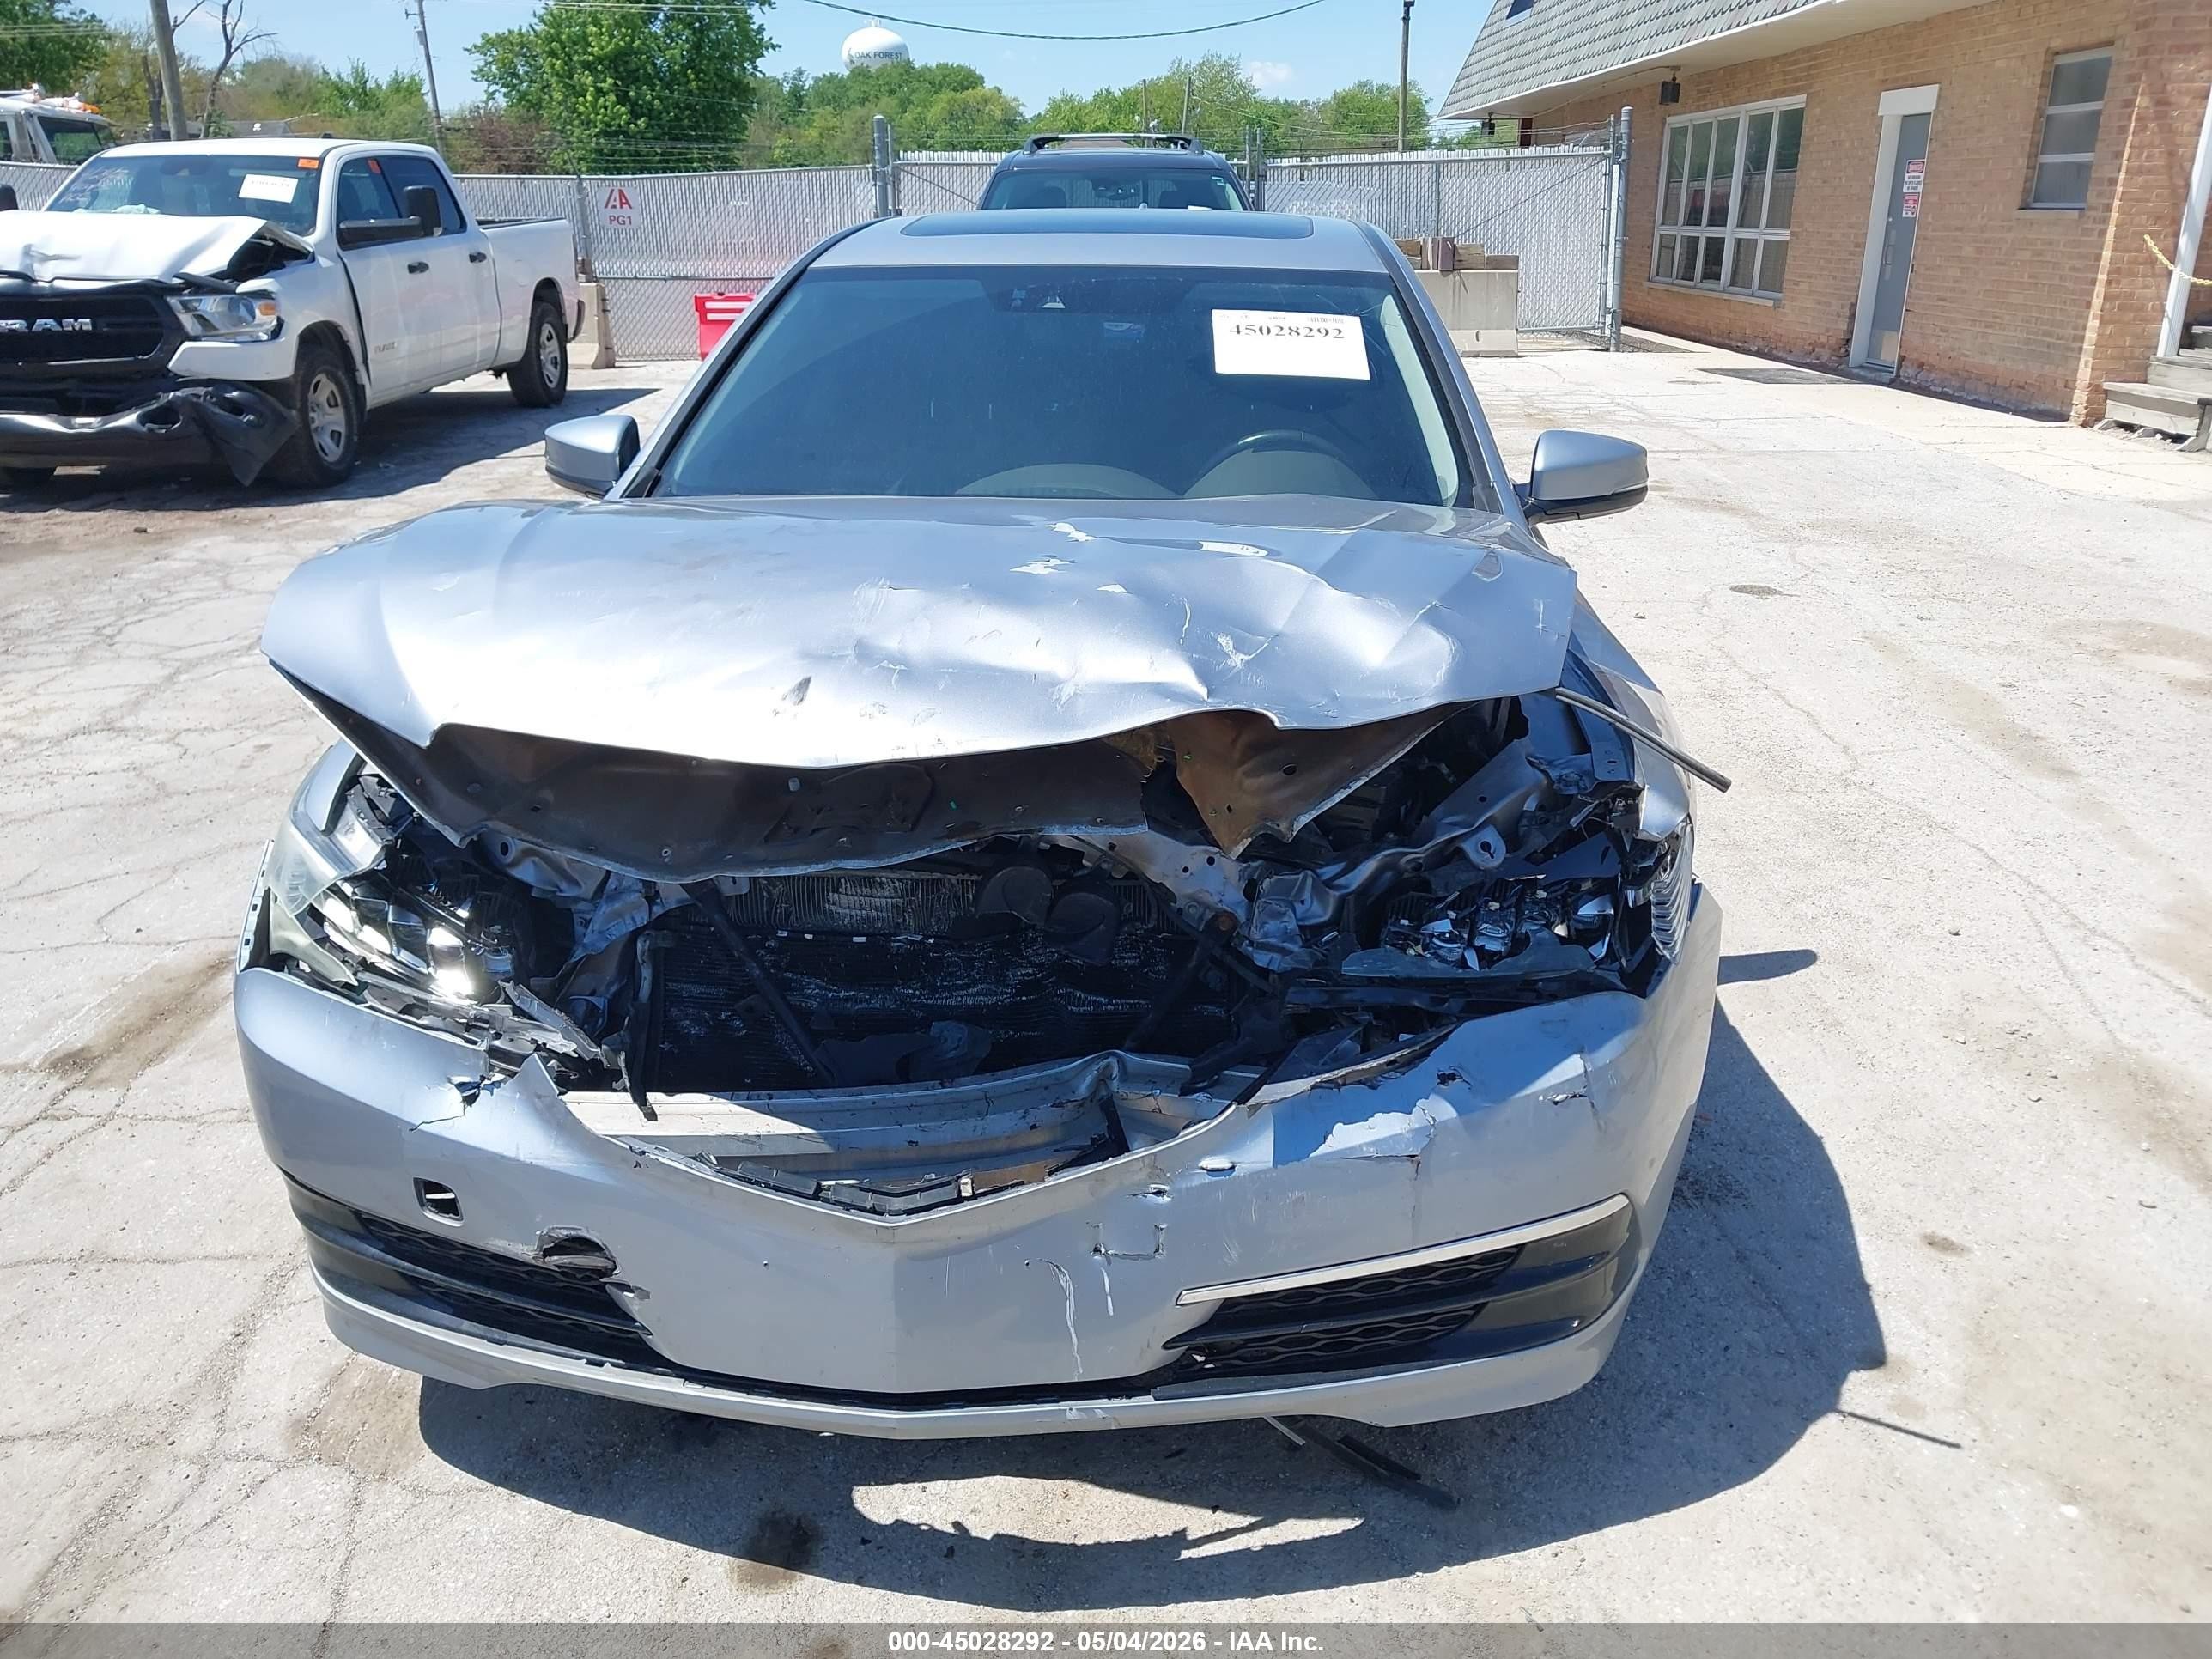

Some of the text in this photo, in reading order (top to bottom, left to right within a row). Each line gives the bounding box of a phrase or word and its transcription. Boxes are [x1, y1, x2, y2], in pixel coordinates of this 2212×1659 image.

[609, 215, 631, 225] PG1
[0, 319, 92, 332] RAM
[1229, 324, 1345, 339] 45028292
